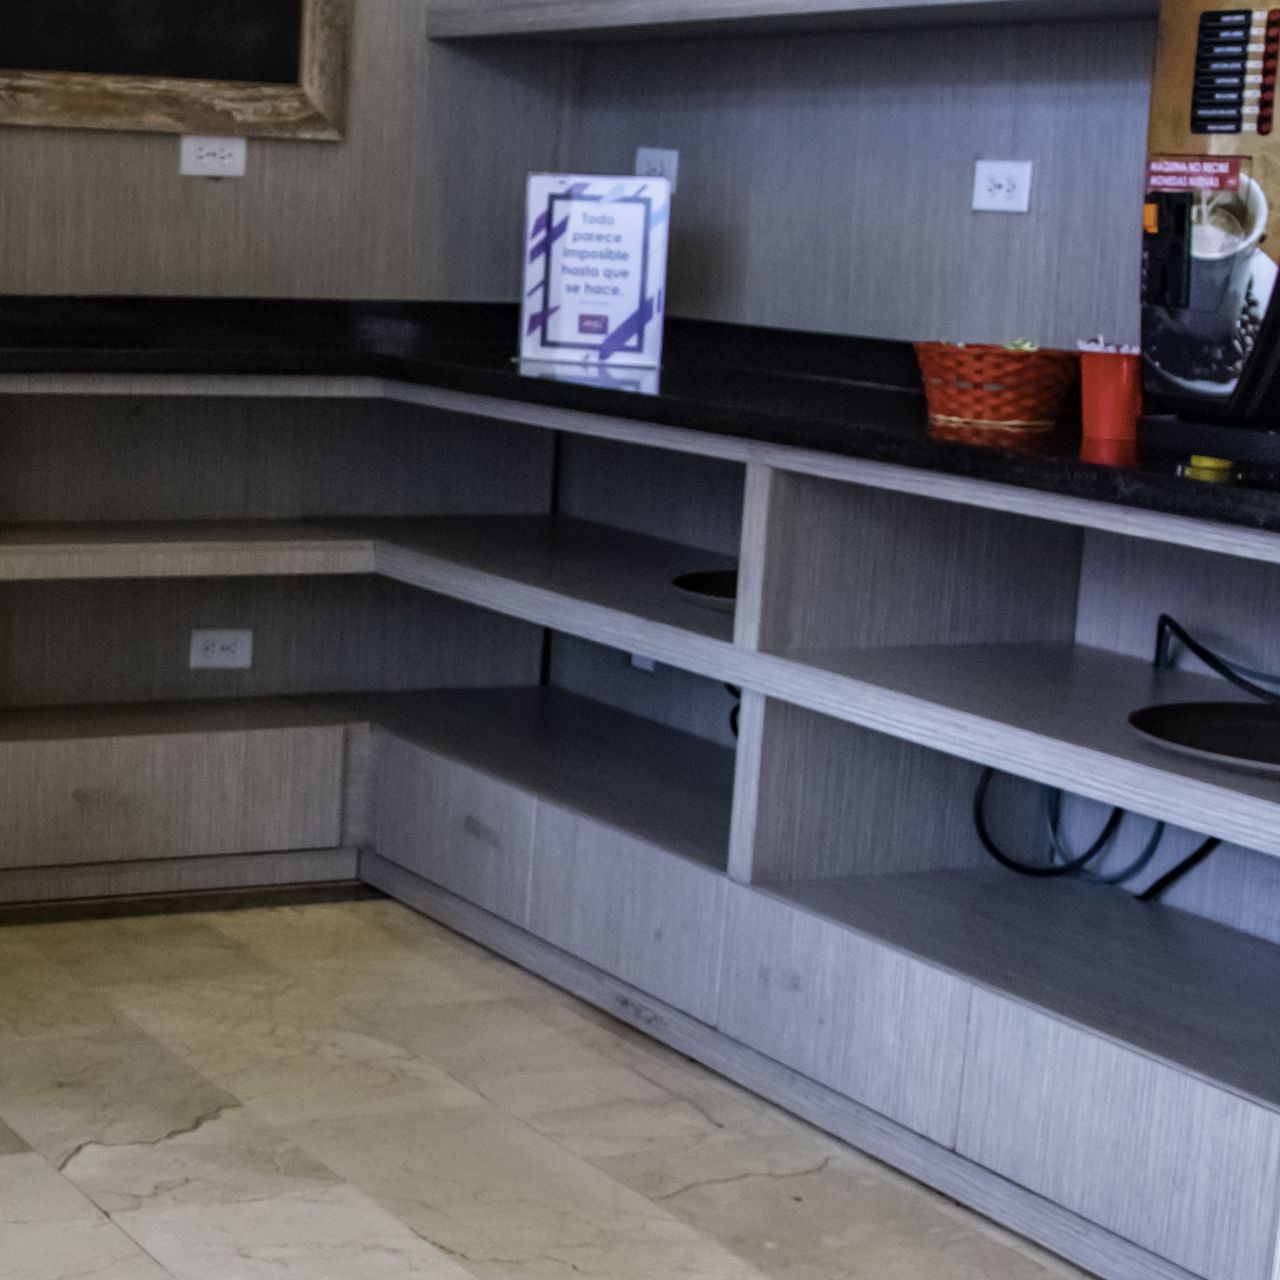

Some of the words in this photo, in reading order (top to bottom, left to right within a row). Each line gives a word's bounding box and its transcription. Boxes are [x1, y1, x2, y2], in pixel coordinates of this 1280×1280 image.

[582, 213, 615, 225] Todo
[573, 232, 623, 243] parece
[561, 265, 599, 277] hasta
[603, 268, 630, 280] que
[565, 284, 581, 294] se
